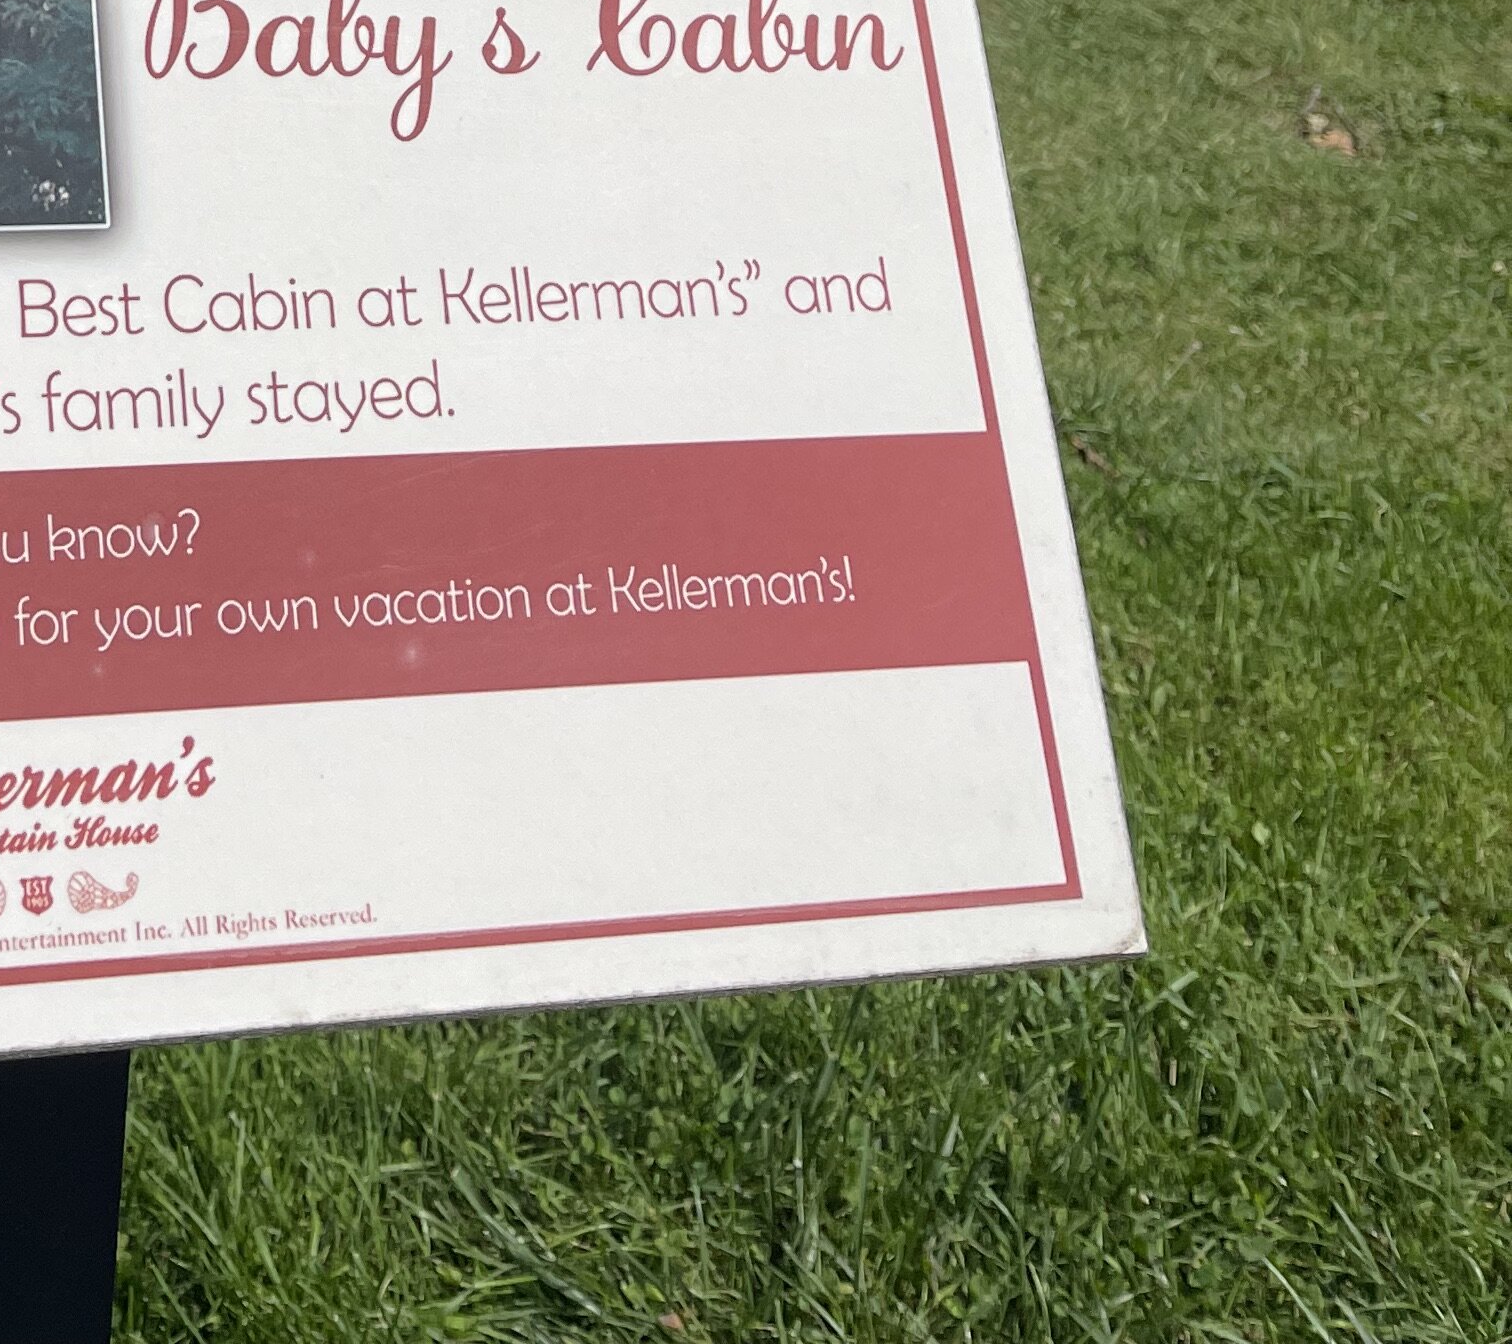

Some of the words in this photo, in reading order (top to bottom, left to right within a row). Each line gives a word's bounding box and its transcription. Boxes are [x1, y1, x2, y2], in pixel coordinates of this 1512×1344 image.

[18, 279, 142, 338] Best
[163, 274, 336, 334] Cabin
[357, 276, 420, 328] at
[440, 261, 760, 324] Kellerman’s”
[784, 256, 892, 315] and
[43, 368, 225, 439] family
[248, 359, 455, 433] stayed.
[47, 508, 199, 560] know?
[15, 597, 77, 645] for
[94, 604, 200, 652] your
[217, 597, 317, 633] own
[334, 580, 531, 627] vacation
[546, 575, 595, 616] at
[608, 556, 855, 612] Kellerman’s!
[64, 816, 159, 849] House
[135, 920, 172, 941] Inc.
[181, 916, 208, 938] All
[216, 912, 277, 939] Rights
[285, 903, 377, 929] Reserved.
